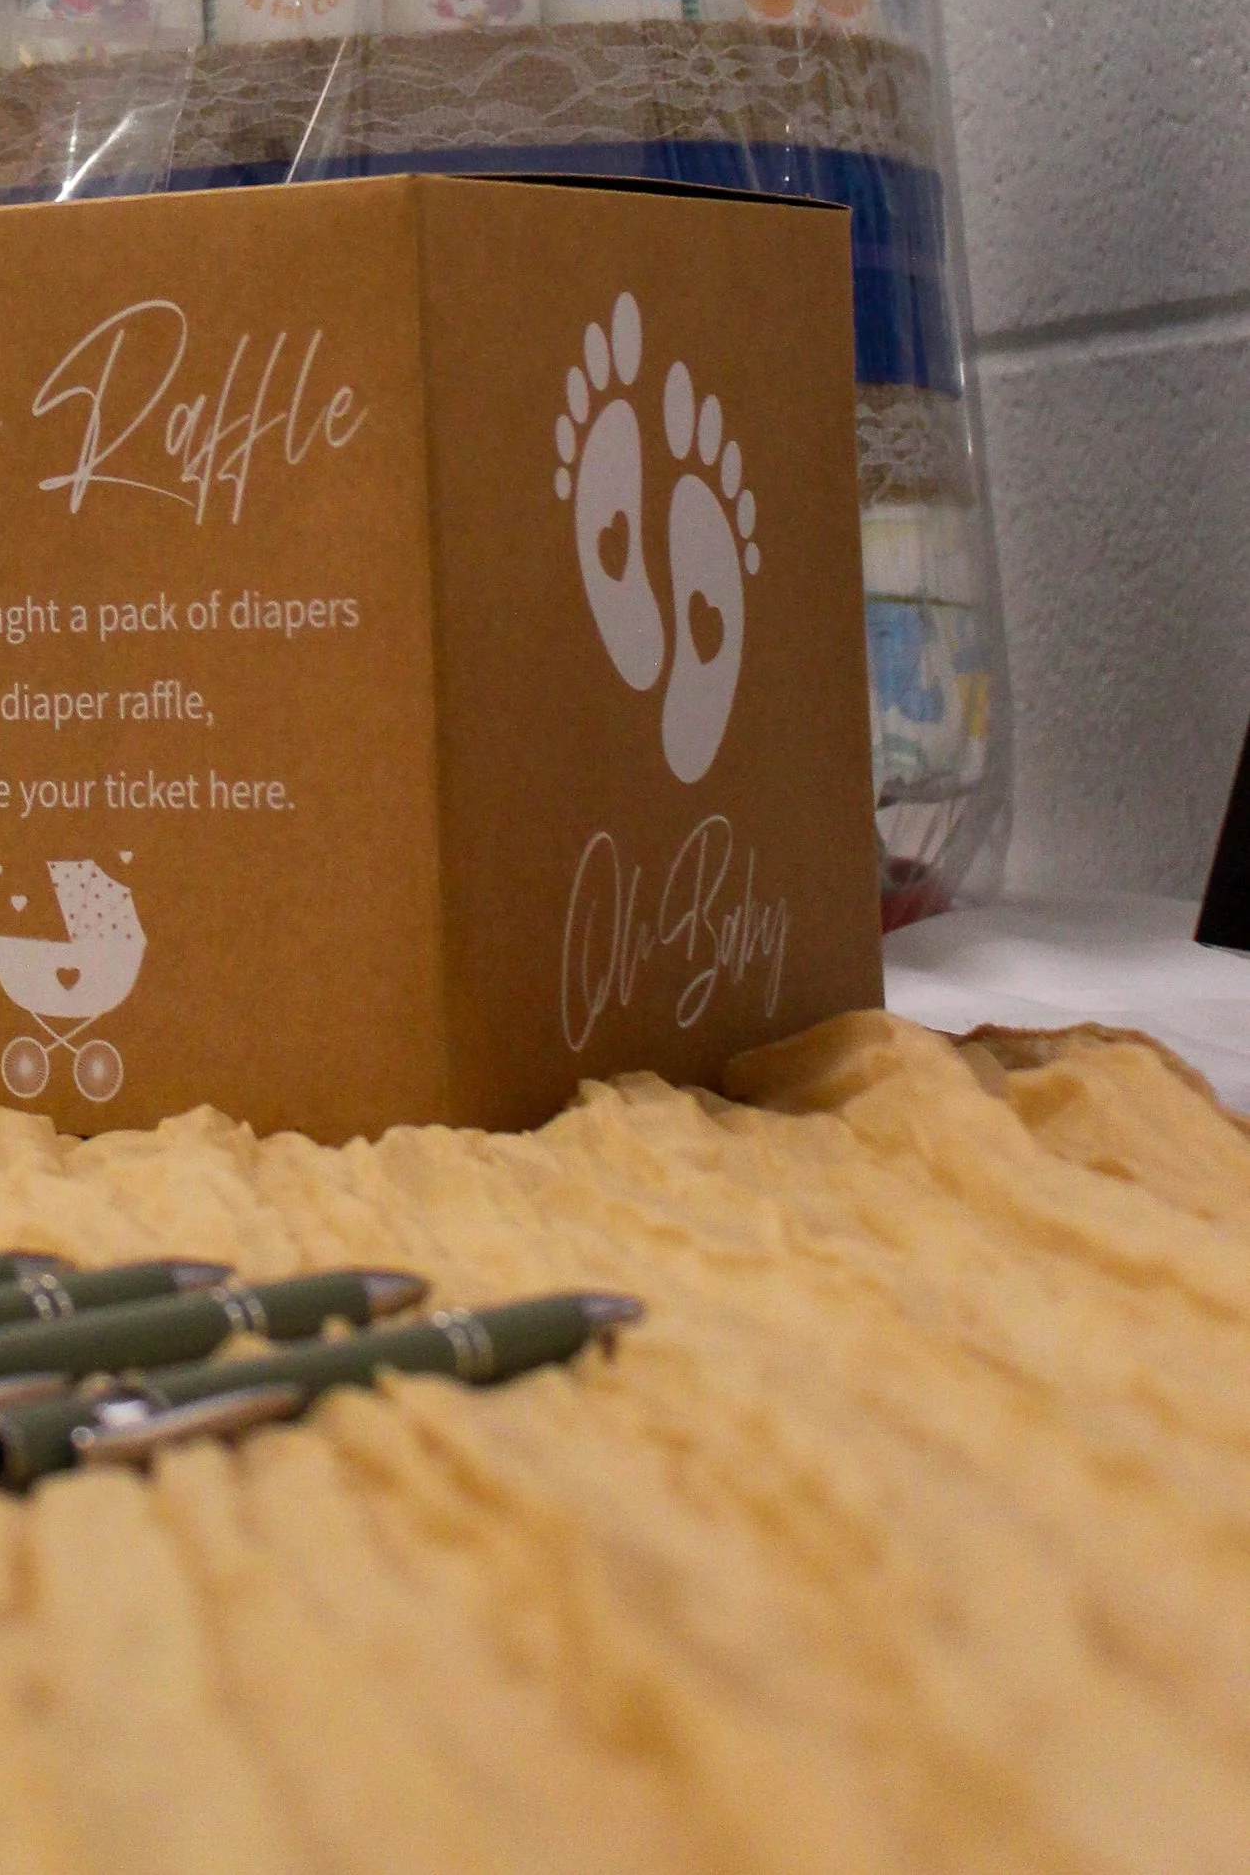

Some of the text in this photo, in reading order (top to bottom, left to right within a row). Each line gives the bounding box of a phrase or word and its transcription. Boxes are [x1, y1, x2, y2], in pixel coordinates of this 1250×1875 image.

[32, 299, 368, 526] Raffle
[68, 606, 88, 631] a
[100, 592, 178, 641] pack
[187, 592, 222, 631] of
[230, 590, 360, 641] diapers
[0, 683, 108, 731] diaper
[117, 680, 214, 727] raffle,
[20, 780, 97, 818] your
[105, 770, 200, 809] ticket
[208, 769, 295, 810] here.
[562, 815, 788, 1052] Oh Baby
